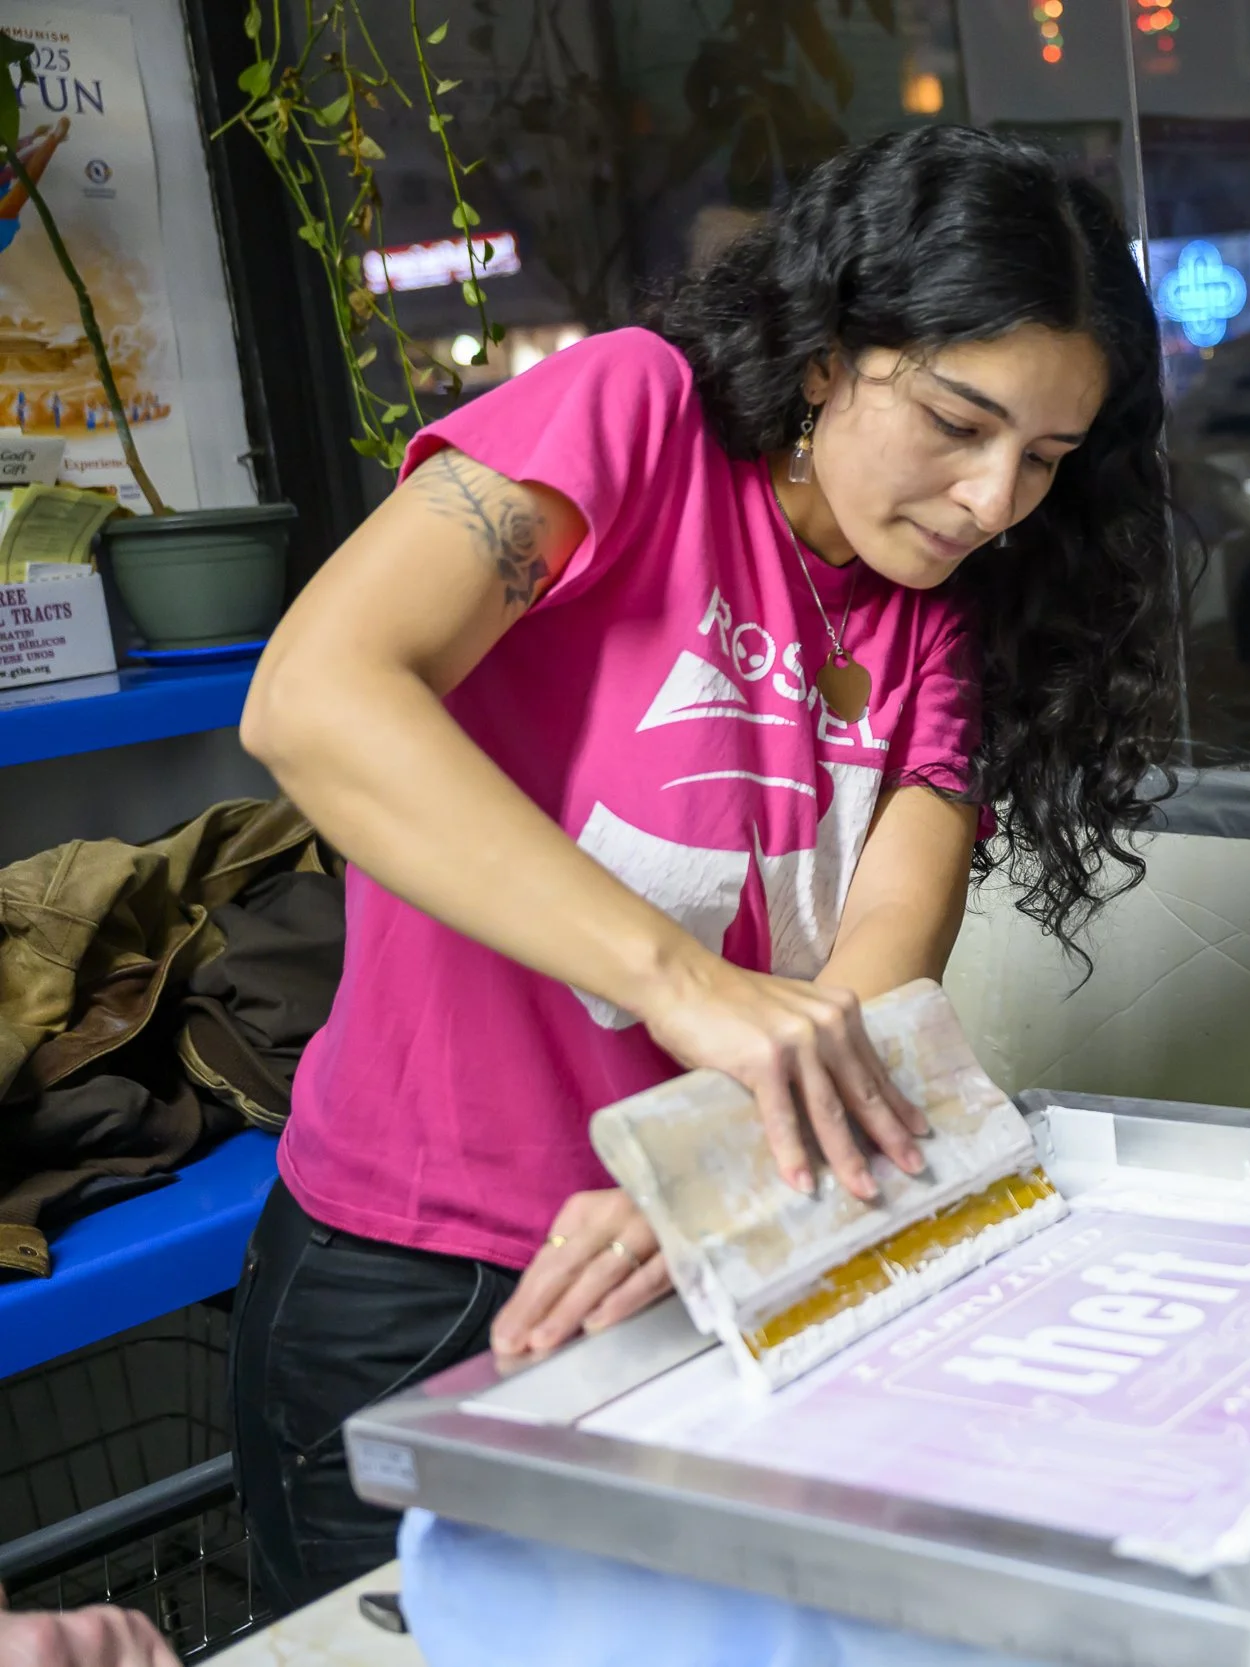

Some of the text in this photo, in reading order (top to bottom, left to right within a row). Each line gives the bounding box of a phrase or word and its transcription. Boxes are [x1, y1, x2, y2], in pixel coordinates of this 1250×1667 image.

[14, 46, 71, 72] 025
[2, 463, 27, 476] Gift
[11, 602, 72, 625] TRACTS
